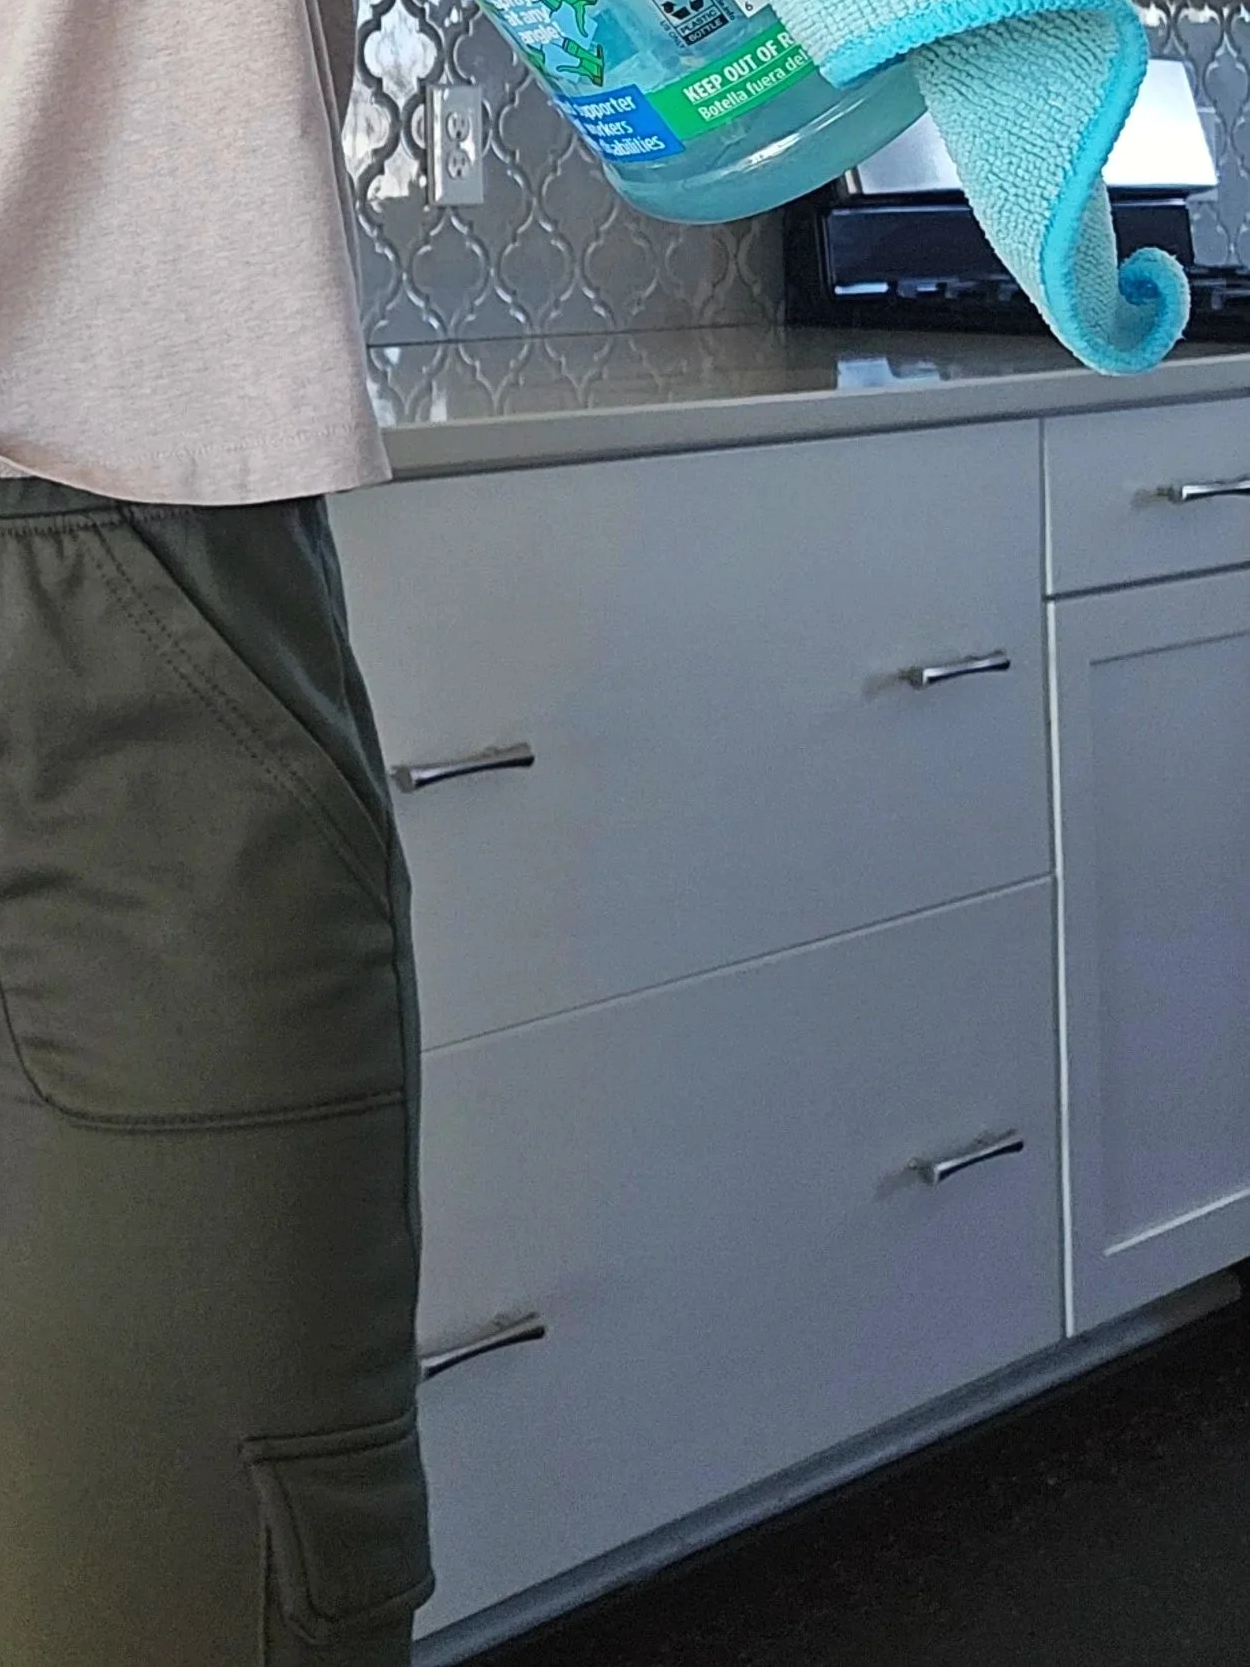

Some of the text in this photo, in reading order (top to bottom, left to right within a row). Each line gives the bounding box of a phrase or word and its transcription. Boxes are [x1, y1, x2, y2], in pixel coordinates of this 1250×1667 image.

[504, 6, 551, 27] at any
[744, 1, 754, 11] 6
[680, 9, 719, 34] PLASTIC
[688, 18, 723, 42] BOTTLE
[683, 74, 723, 102] KEEP
[723, 54, 758, 82] OUT
[756, 40, 778, 62] OF
[698, 49, 809, 122] Botella fuera del
